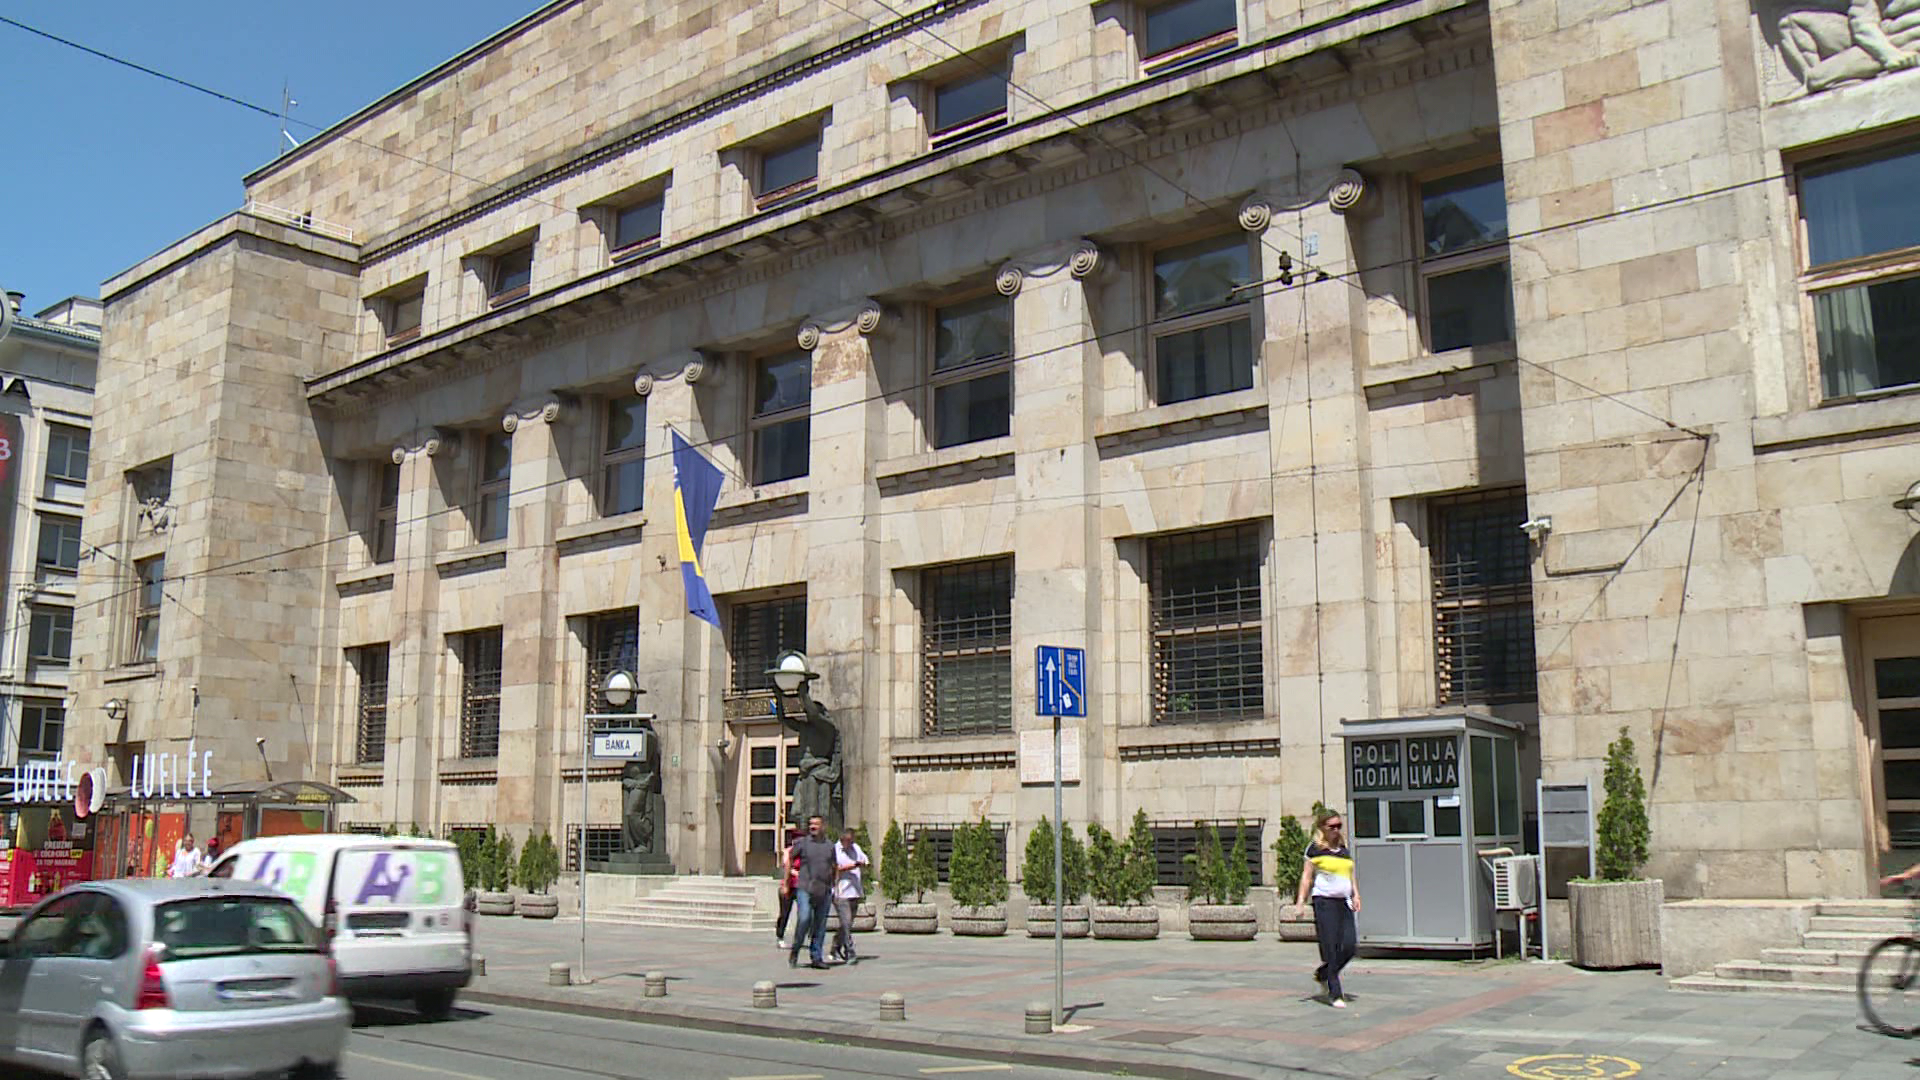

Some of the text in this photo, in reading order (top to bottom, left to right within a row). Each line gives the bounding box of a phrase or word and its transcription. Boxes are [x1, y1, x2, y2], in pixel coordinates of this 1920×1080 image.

[605, 739, 630, 750] BANKA
[1353, 741, 1456, 765] POLICIJA
[131, 737, 213, 799] LUFLÉE
[1354, 764, 1457, 788] ПОЛИЦИЈА
